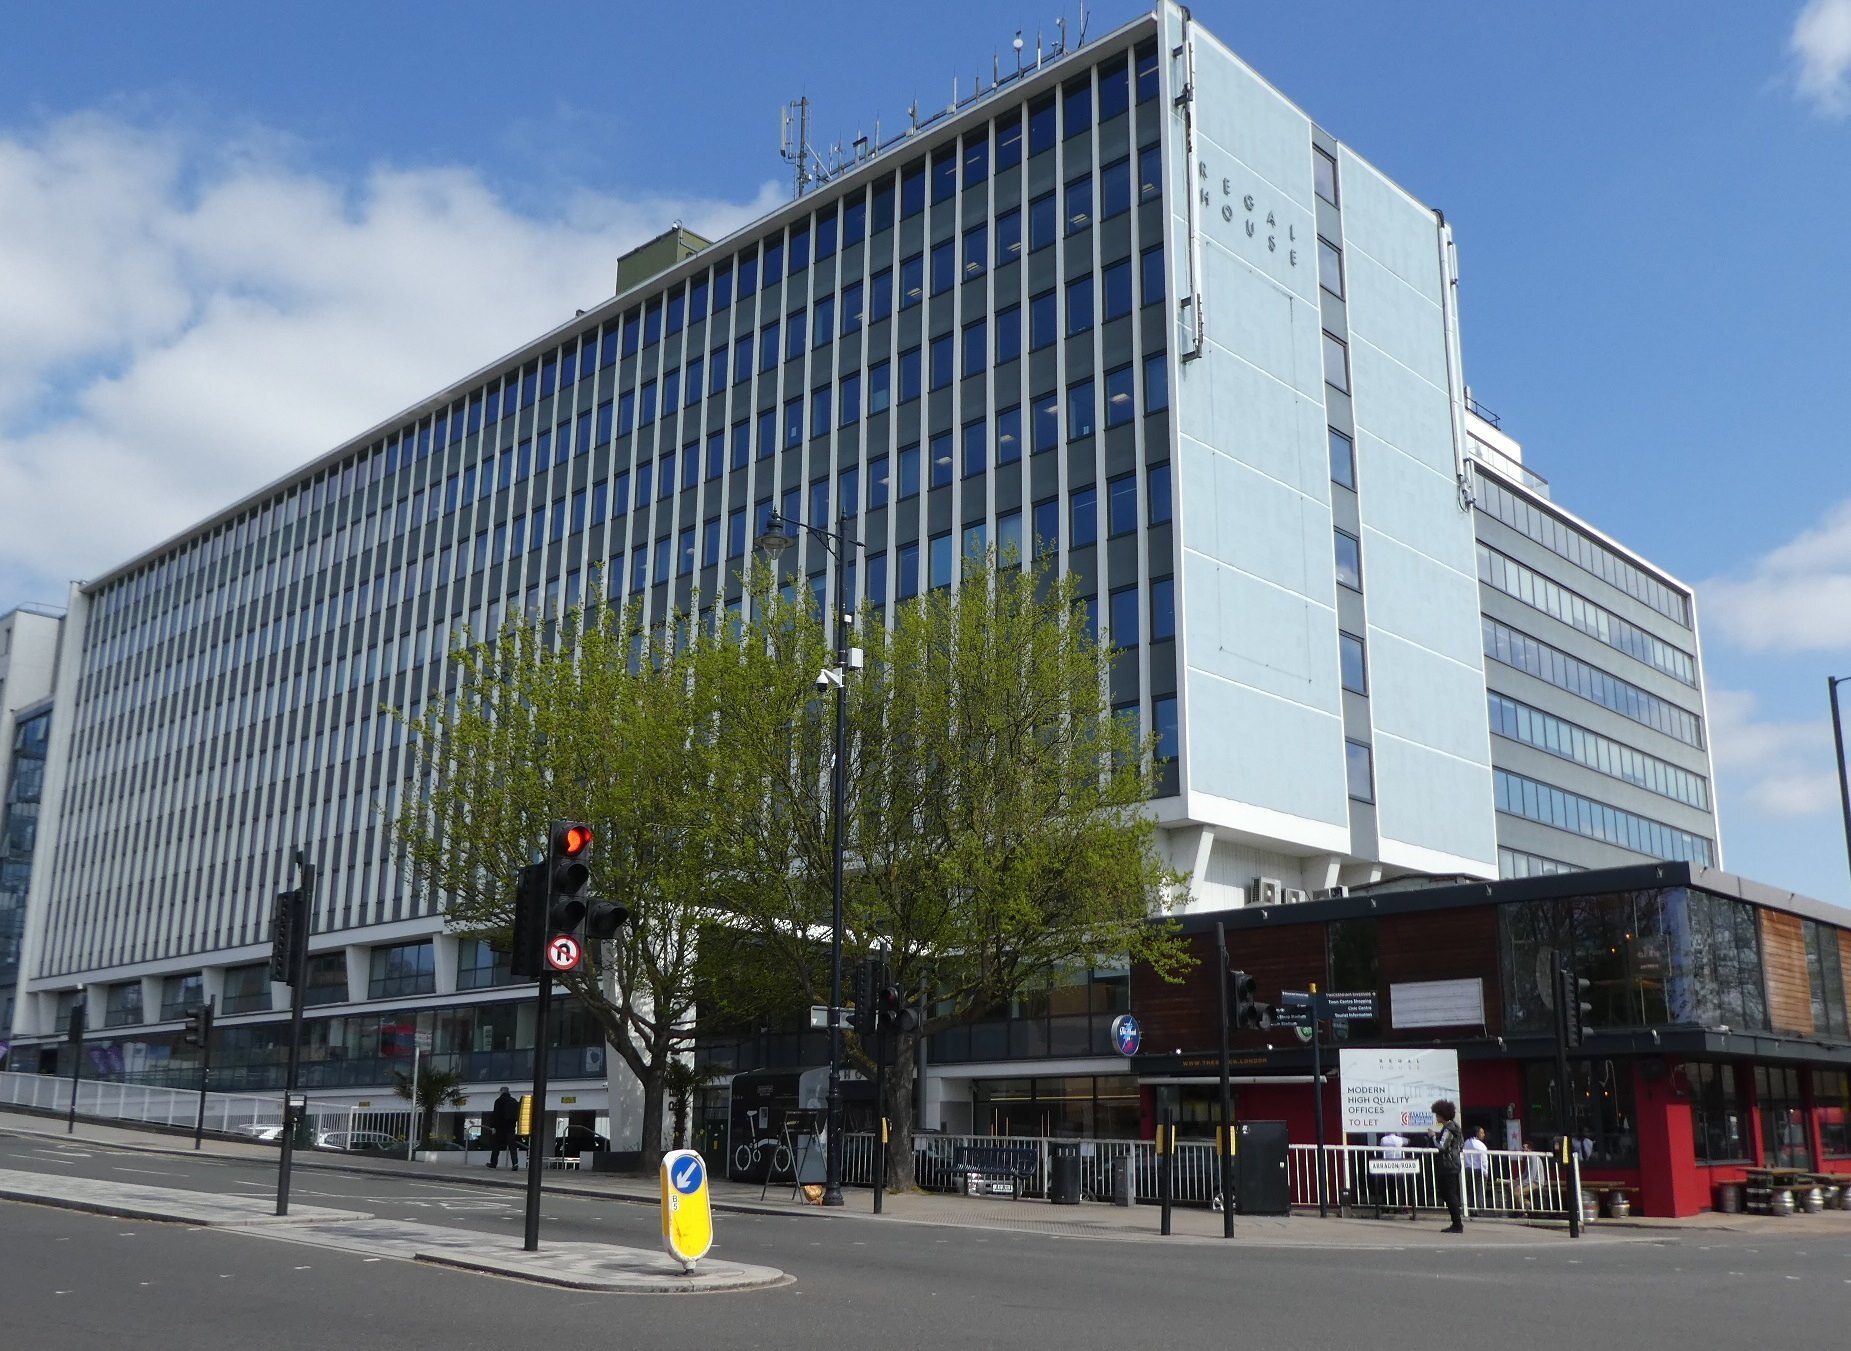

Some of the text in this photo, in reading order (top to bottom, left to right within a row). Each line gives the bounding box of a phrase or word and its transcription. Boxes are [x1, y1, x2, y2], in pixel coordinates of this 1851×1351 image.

[1198, 160, 1296, 242] REGAL
[1199, 187, 1298, 268] HOUSE
[1347, 1086, 1386, 1094] MODERN
[1347, 1096, 1410, 1105] HIGH QUALITY
[1348, 1106, 1385, 1114] OFFICES
[1349, 1119, 1379, 1127] TO LET
